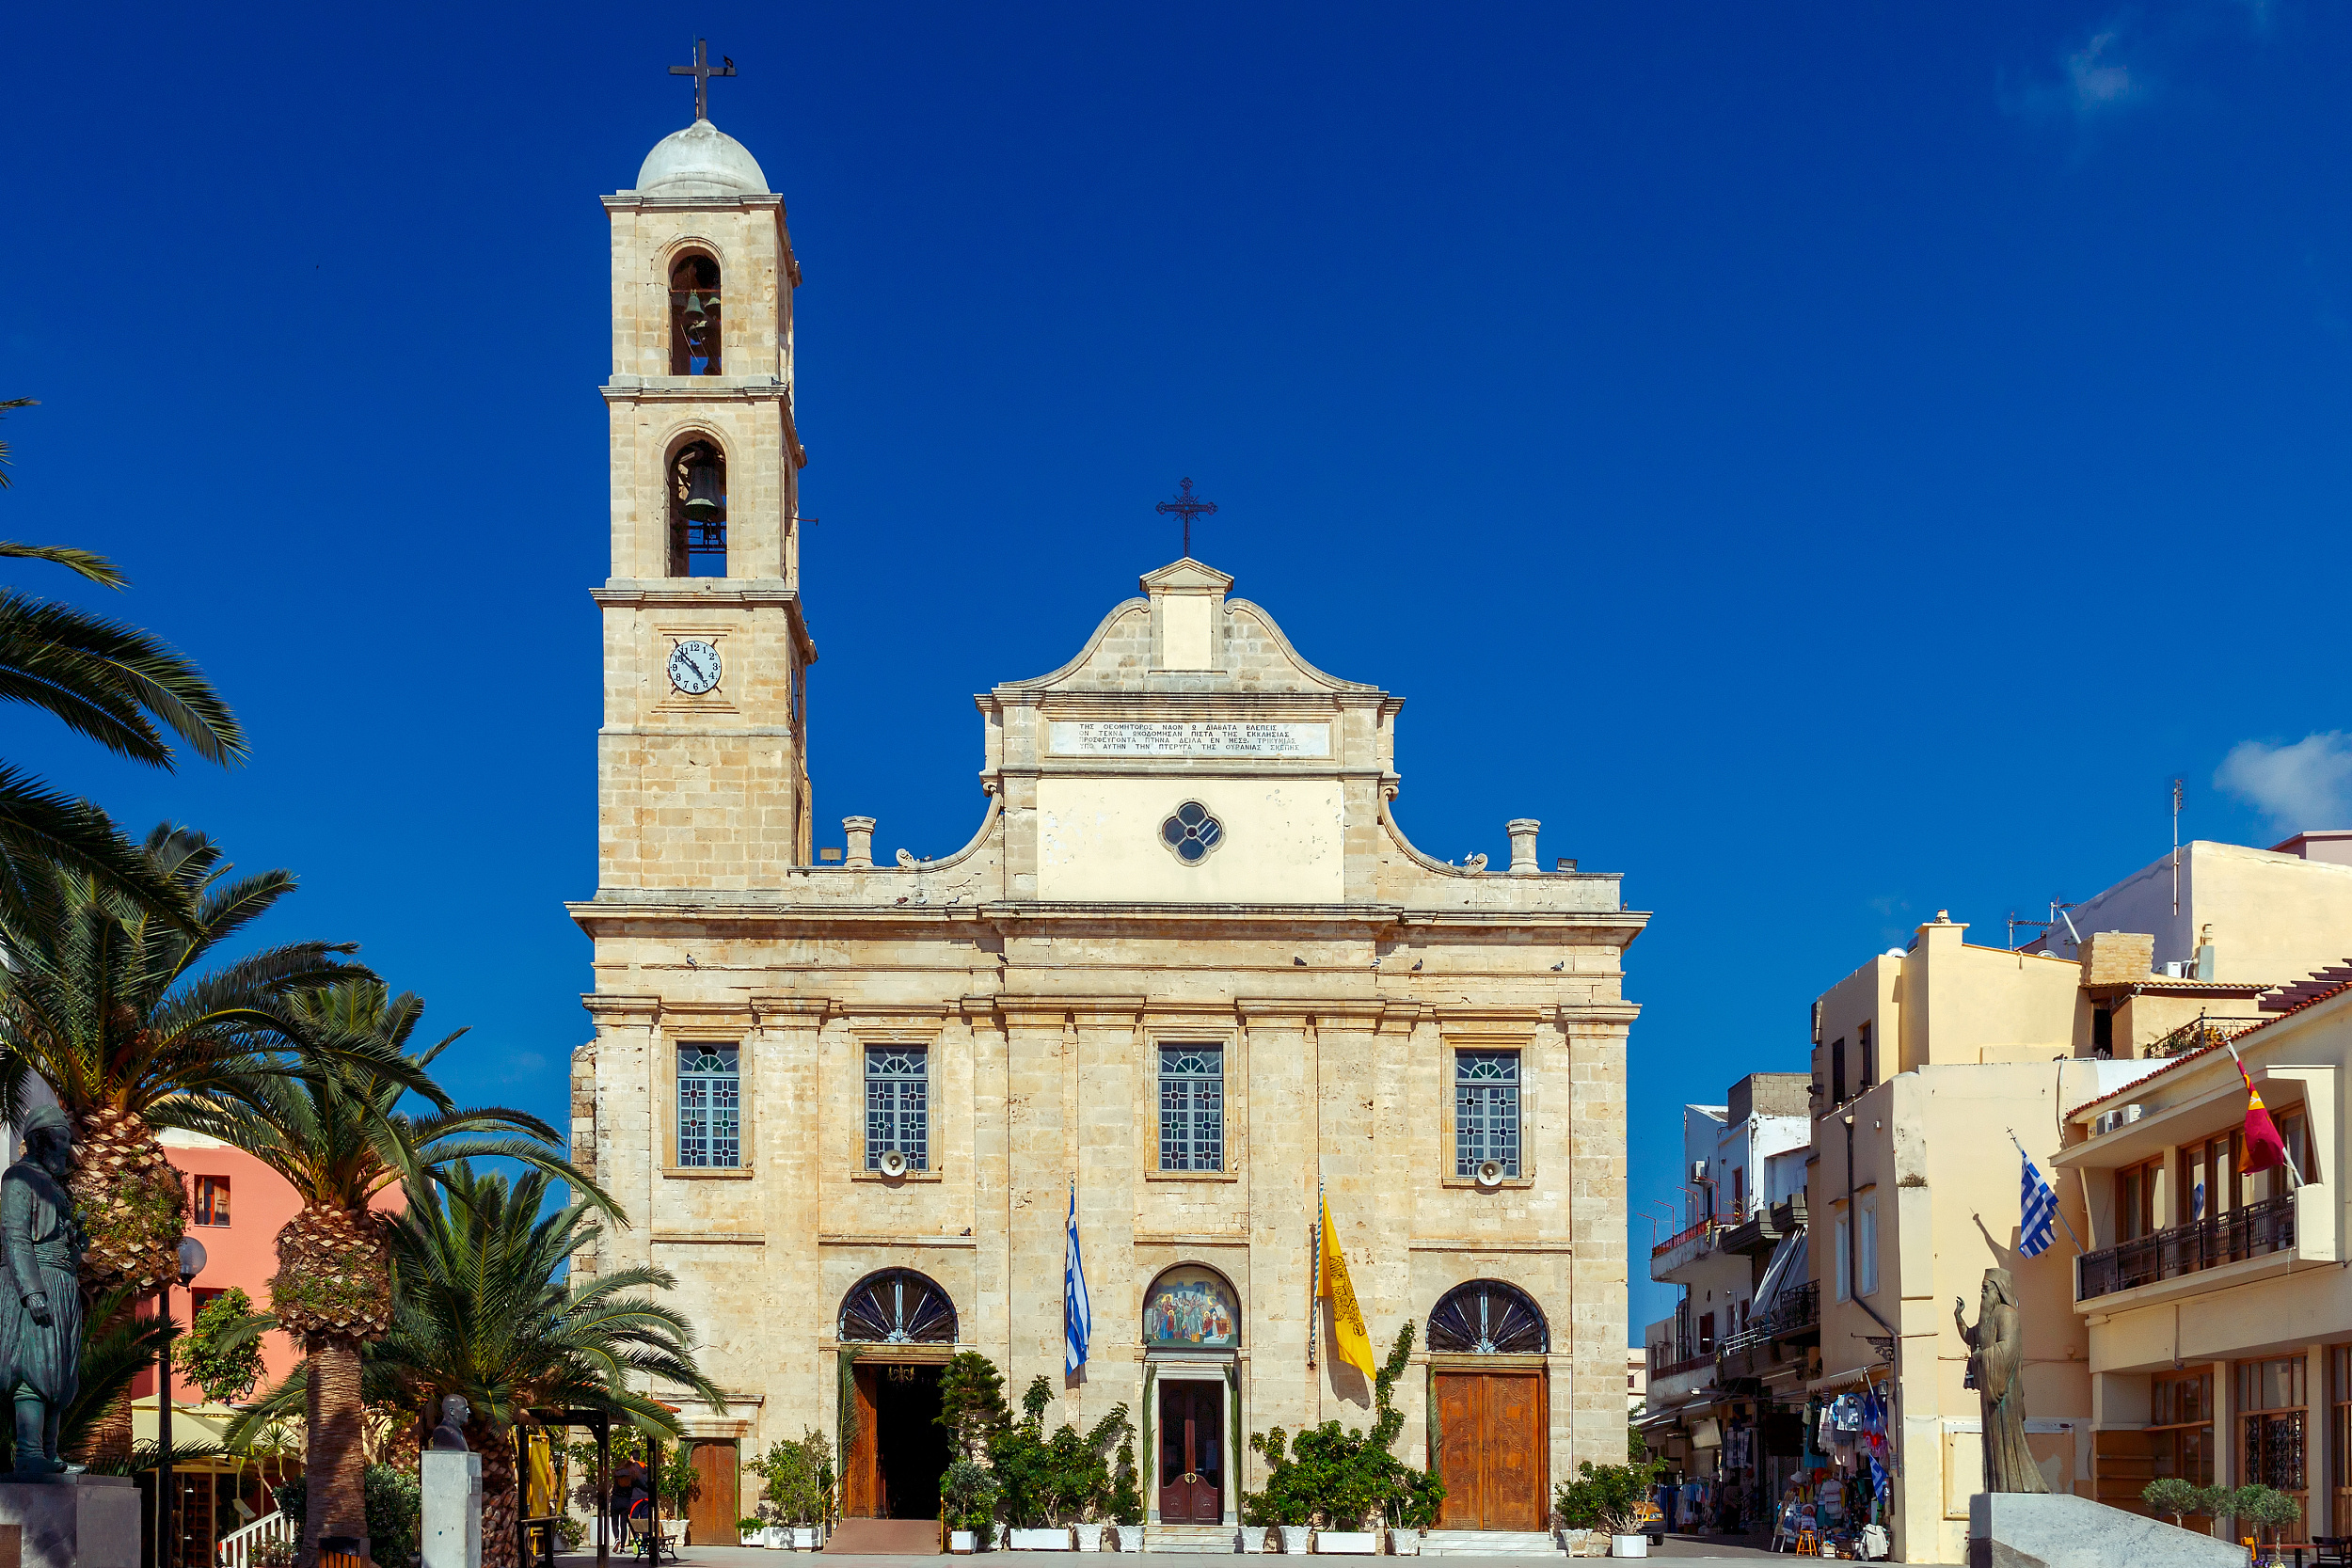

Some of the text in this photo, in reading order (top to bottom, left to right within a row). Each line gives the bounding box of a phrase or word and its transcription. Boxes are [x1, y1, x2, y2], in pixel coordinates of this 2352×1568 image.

[690, 643, 700, 652] 12
[708, 652, 715, 660] 2
[672, 663, 678, 672] 9
[712, 662, 719, 671] 3
[675, 673, 681, 682] 8
[708, 672, 715, 680] 4
[683, 680, 690, 689] 7
[692, 682, 699, 690] 6
[703, 679, 708, 689] 5
